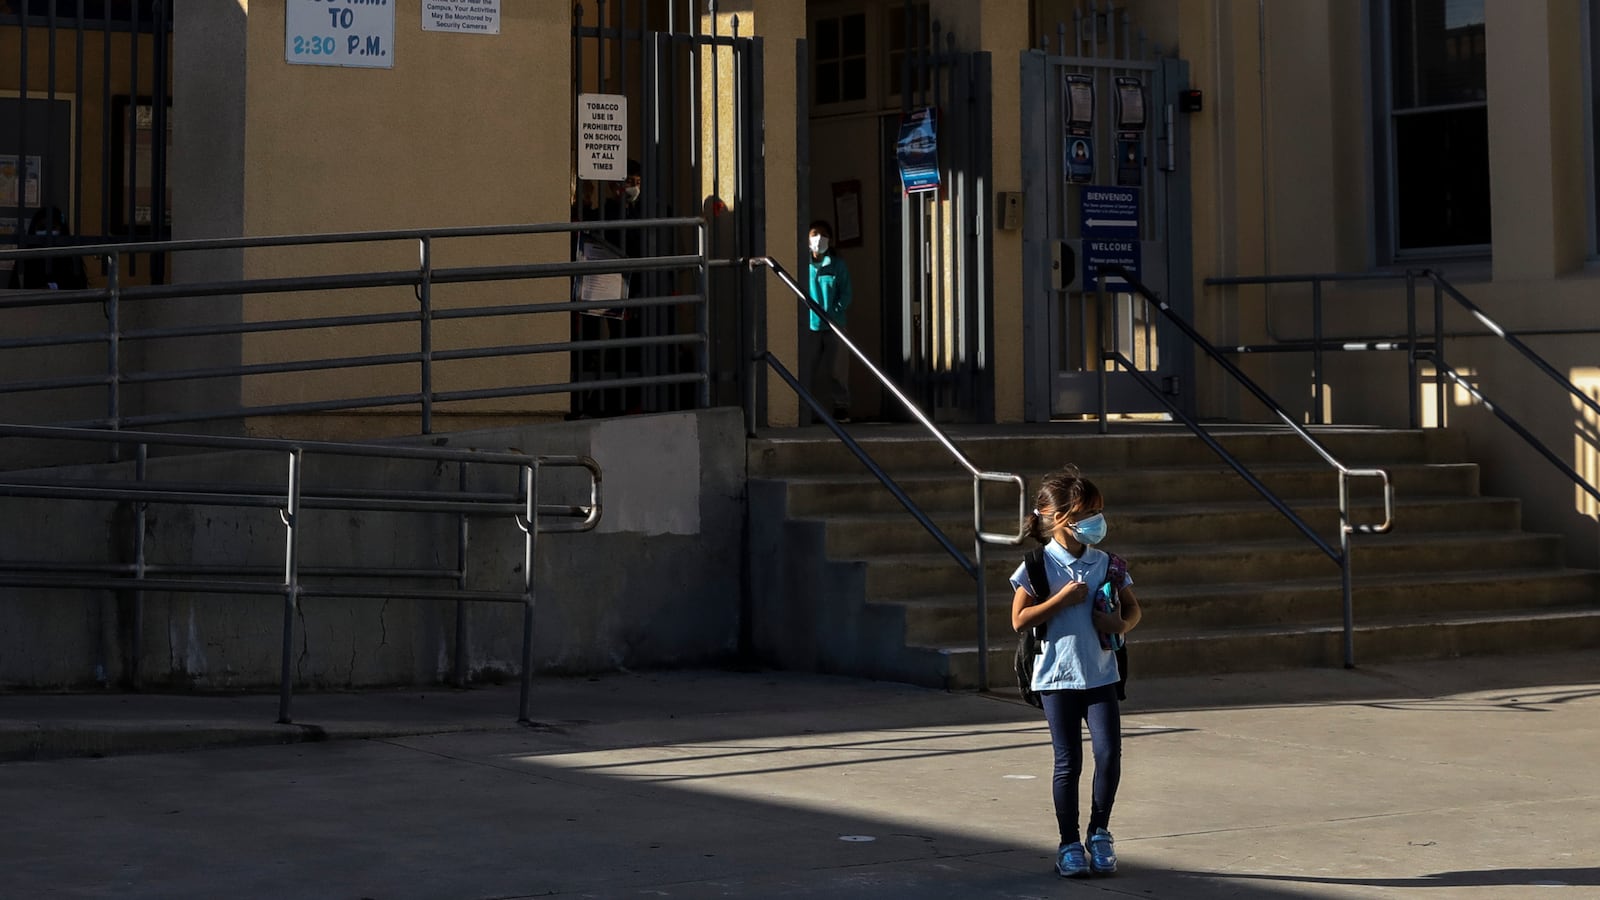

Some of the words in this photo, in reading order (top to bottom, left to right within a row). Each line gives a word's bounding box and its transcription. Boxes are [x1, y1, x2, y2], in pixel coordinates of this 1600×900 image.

[470, 6, 496, 14] Activities
[328, 8, 354, 29] TO
[431, 12, 443, 20] May
[454, 13, 483, 21] Monitored
[485, 15, 492, 23] by
[436, 21, 460, 29] Security
[462, 22, 487, 30] Cameras
[293, 35, 336, 55] 2:30
[347, 35, 386, 56] P.M.
[587, 103, 619, 111] TOBACCO
[582, 123, 623, 131] PROHIBITED
[583, 132, 594, 140] ON
[595, 133, 622, 141] SCHOOL
[585, 143, 620, 151] PROPERTY
[1087, 192, 1133, 201] BIENVENIDO
[1091, 243, 1133, 251] WELCOME
